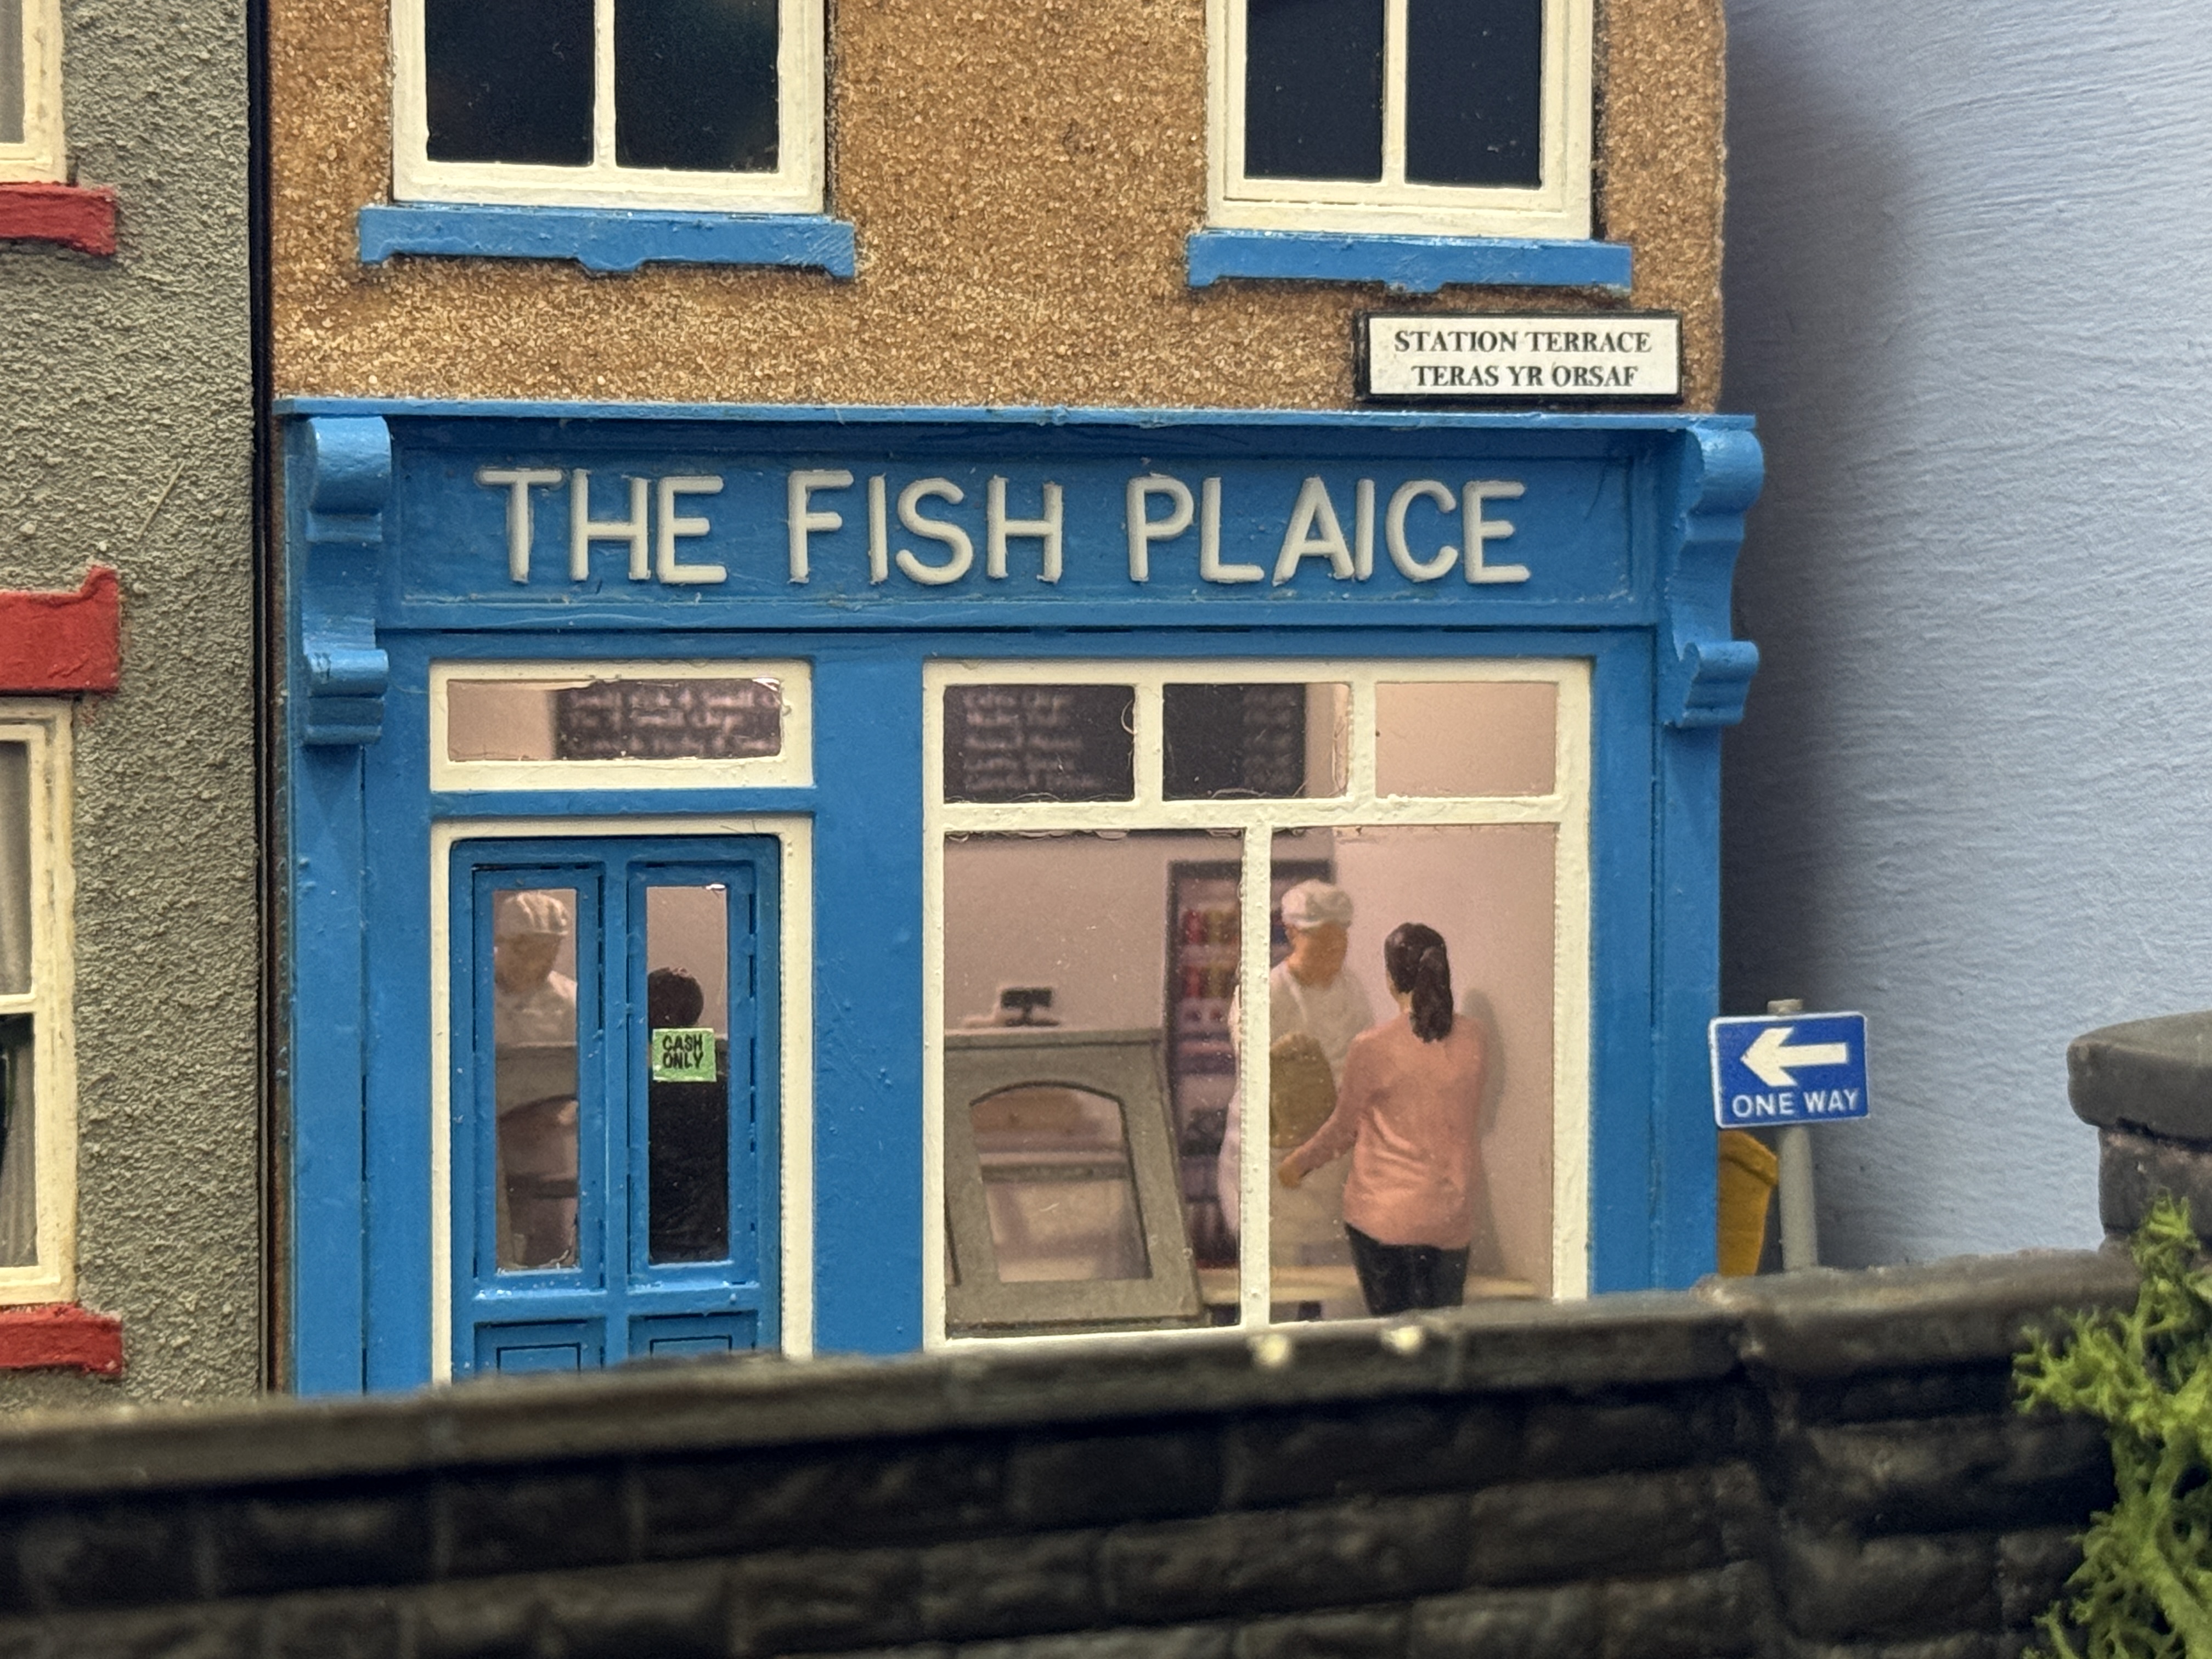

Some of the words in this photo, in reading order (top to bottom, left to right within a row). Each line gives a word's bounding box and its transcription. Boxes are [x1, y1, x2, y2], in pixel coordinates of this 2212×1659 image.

[1394, 330, 1517, 353] STATION
[1526, 331, 1651, 353] TERRACE
[1412, 365, 1499, 387] TERAS
[1506, 366, 1542, 386] YR
[1552, 365, 1638, 387] ORSAF
[476, 469, 727, 584] THE
[788, 469, 1063, 585] FISH
[1126, 474, 1531, 585] PLAICE
[662, 1034, 703, 1052] CASH
[662, 1051, 704, 1069] ONLY
[1732, 1092, 1795, 1118] ONE
[1804, 1089, 1858, 1113] WAY
